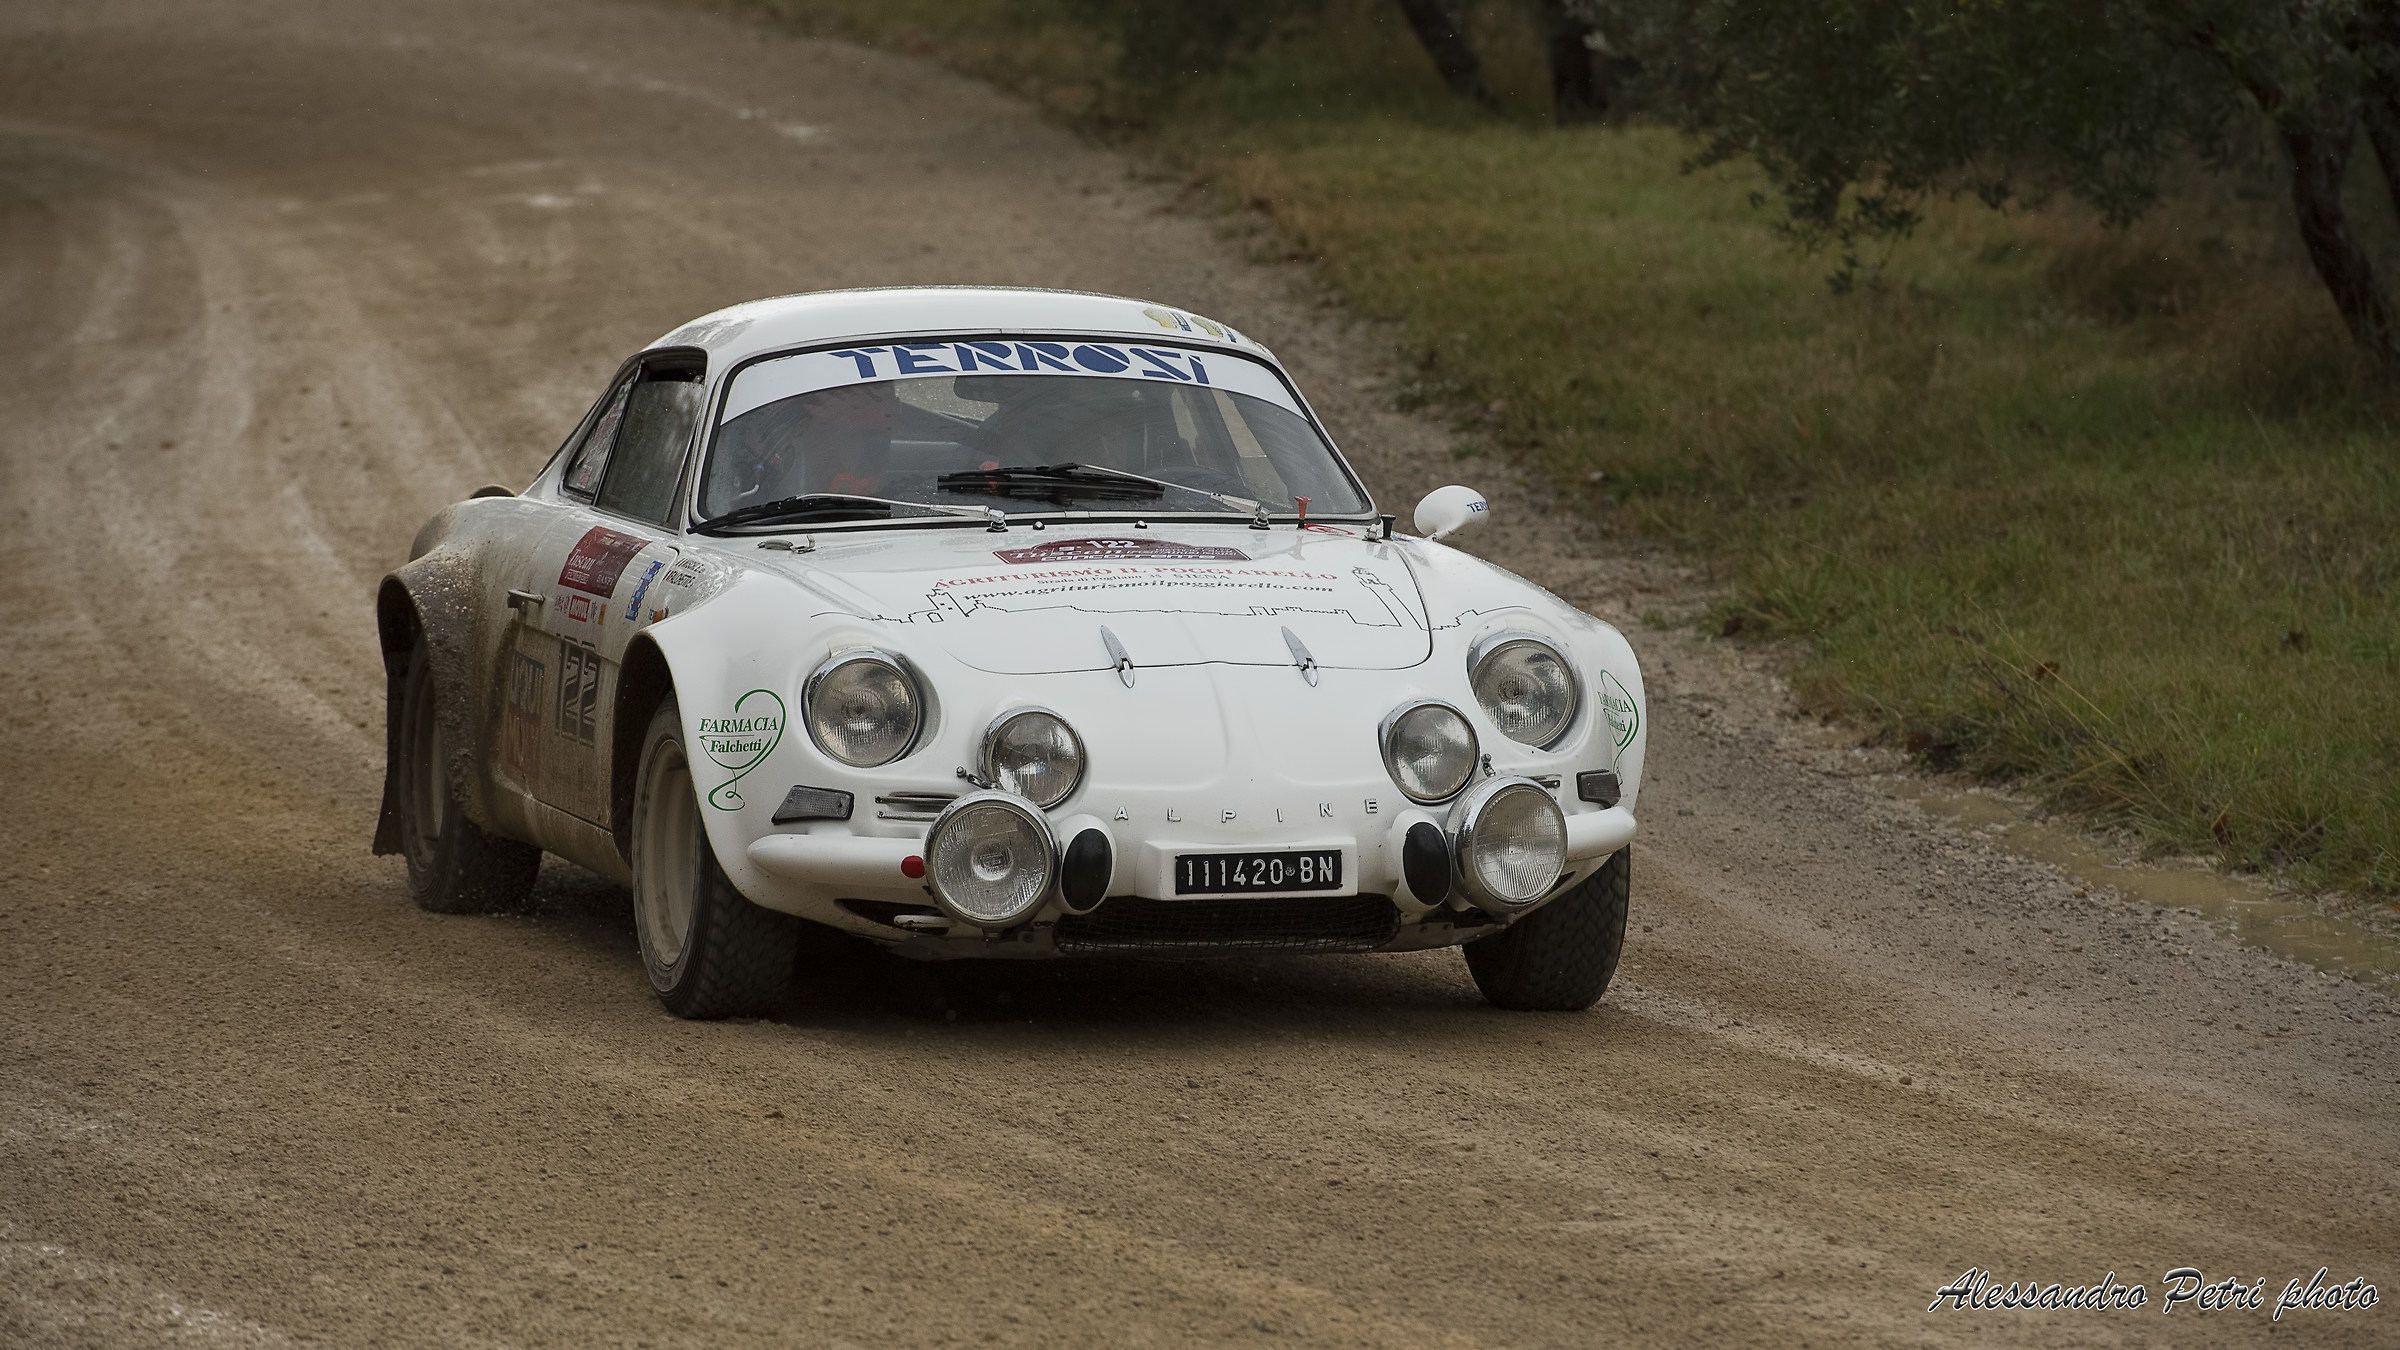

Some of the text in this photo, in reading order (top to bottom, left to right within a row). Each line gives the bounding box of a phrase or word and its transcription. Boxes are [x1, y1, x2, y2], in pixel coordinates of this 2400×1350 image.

[1086, 540, 1140, 548] 122
[568, 548, 597, 570] Tuscan
[933, 567, 1112, 588] AGRITURISMO
[1155, 568, 1338, 580] POGGIARELLO
[963, 579, 1333, 600] www.agriturismoilpoggiarello.com
[555, 632, 600, 749] 122
[699, 717, 778, 732] FARMACIA
[710, 738, 762, 753] Falchetti
[1114, 799, 1378, 823] ALPINE
[1187, 855, 1334, 887] 111420 BN
